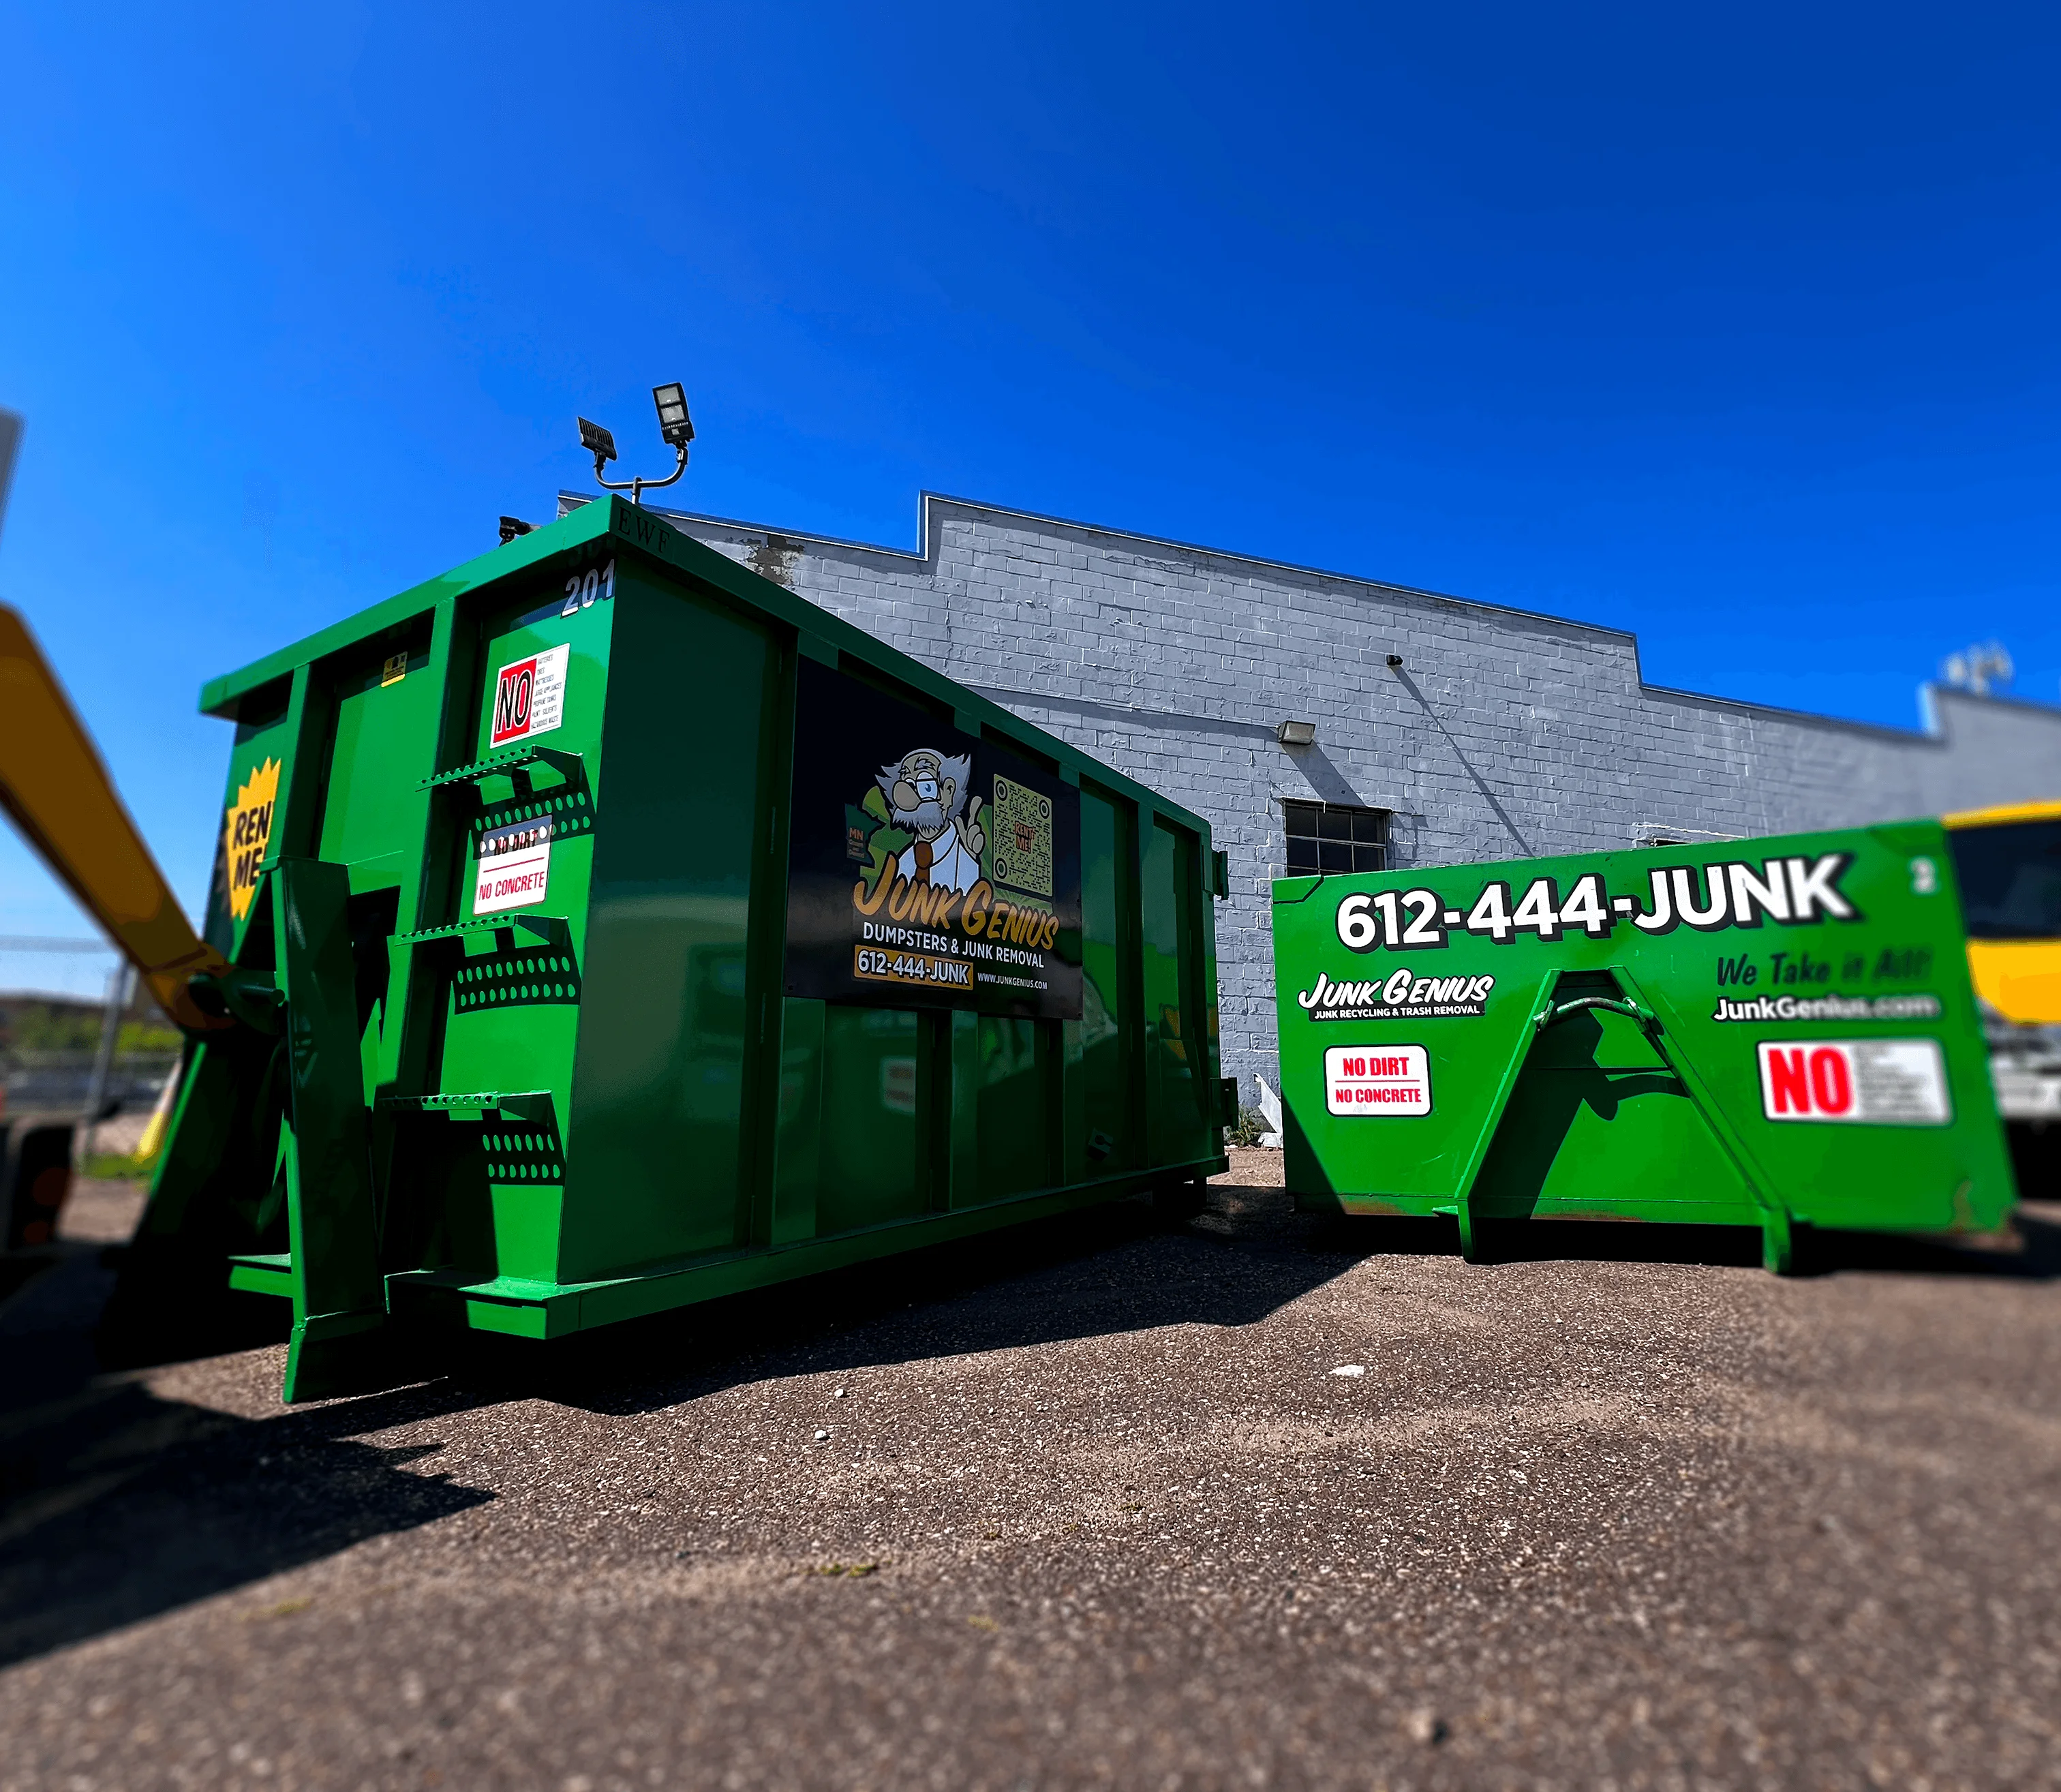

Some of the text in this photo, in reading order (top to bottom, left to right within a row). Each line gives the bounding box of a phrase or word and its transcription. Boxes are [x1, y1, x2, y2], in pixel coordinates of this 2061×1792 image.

[618, 506, 670, 553] EWF
[561, 558, 615, 618] 201
[496, 669, 532, 734] NO
[494, 829, 538, 855] NO DIRT
[849, 827, 864, 841] MN
[1015, 821, 1033, 840] RENT
[479, 871, 545, 900] NO CONCRETE
[853, 854, 1060, 950] JUNK GENIUS
[1337, 853, 1858, 950] 612-444-JUNK
[863, 921, 1045, 969] DUMPSTERS & JUNK REMOVAL
[857, 949, 969, 984] 612-444-JUNK
[977, 972, 1048, 990] WWW.JUNKGENIUS.COM
[1717, 953, 1758, 987] We
[1771, 952, 1831, 986] Take
[1298, 968, 1496, 1009] JUNK GENIUS
[1314, 1005, 1480, 1019] JUNK RECYCLING & TRASH REMOVAL
[1343, 1057, 1409, 1076] NO DIRT
[1767, 1045, 1854, 1118] NO
[1336, 1089, 1421, 1103] NO CONCRETE
